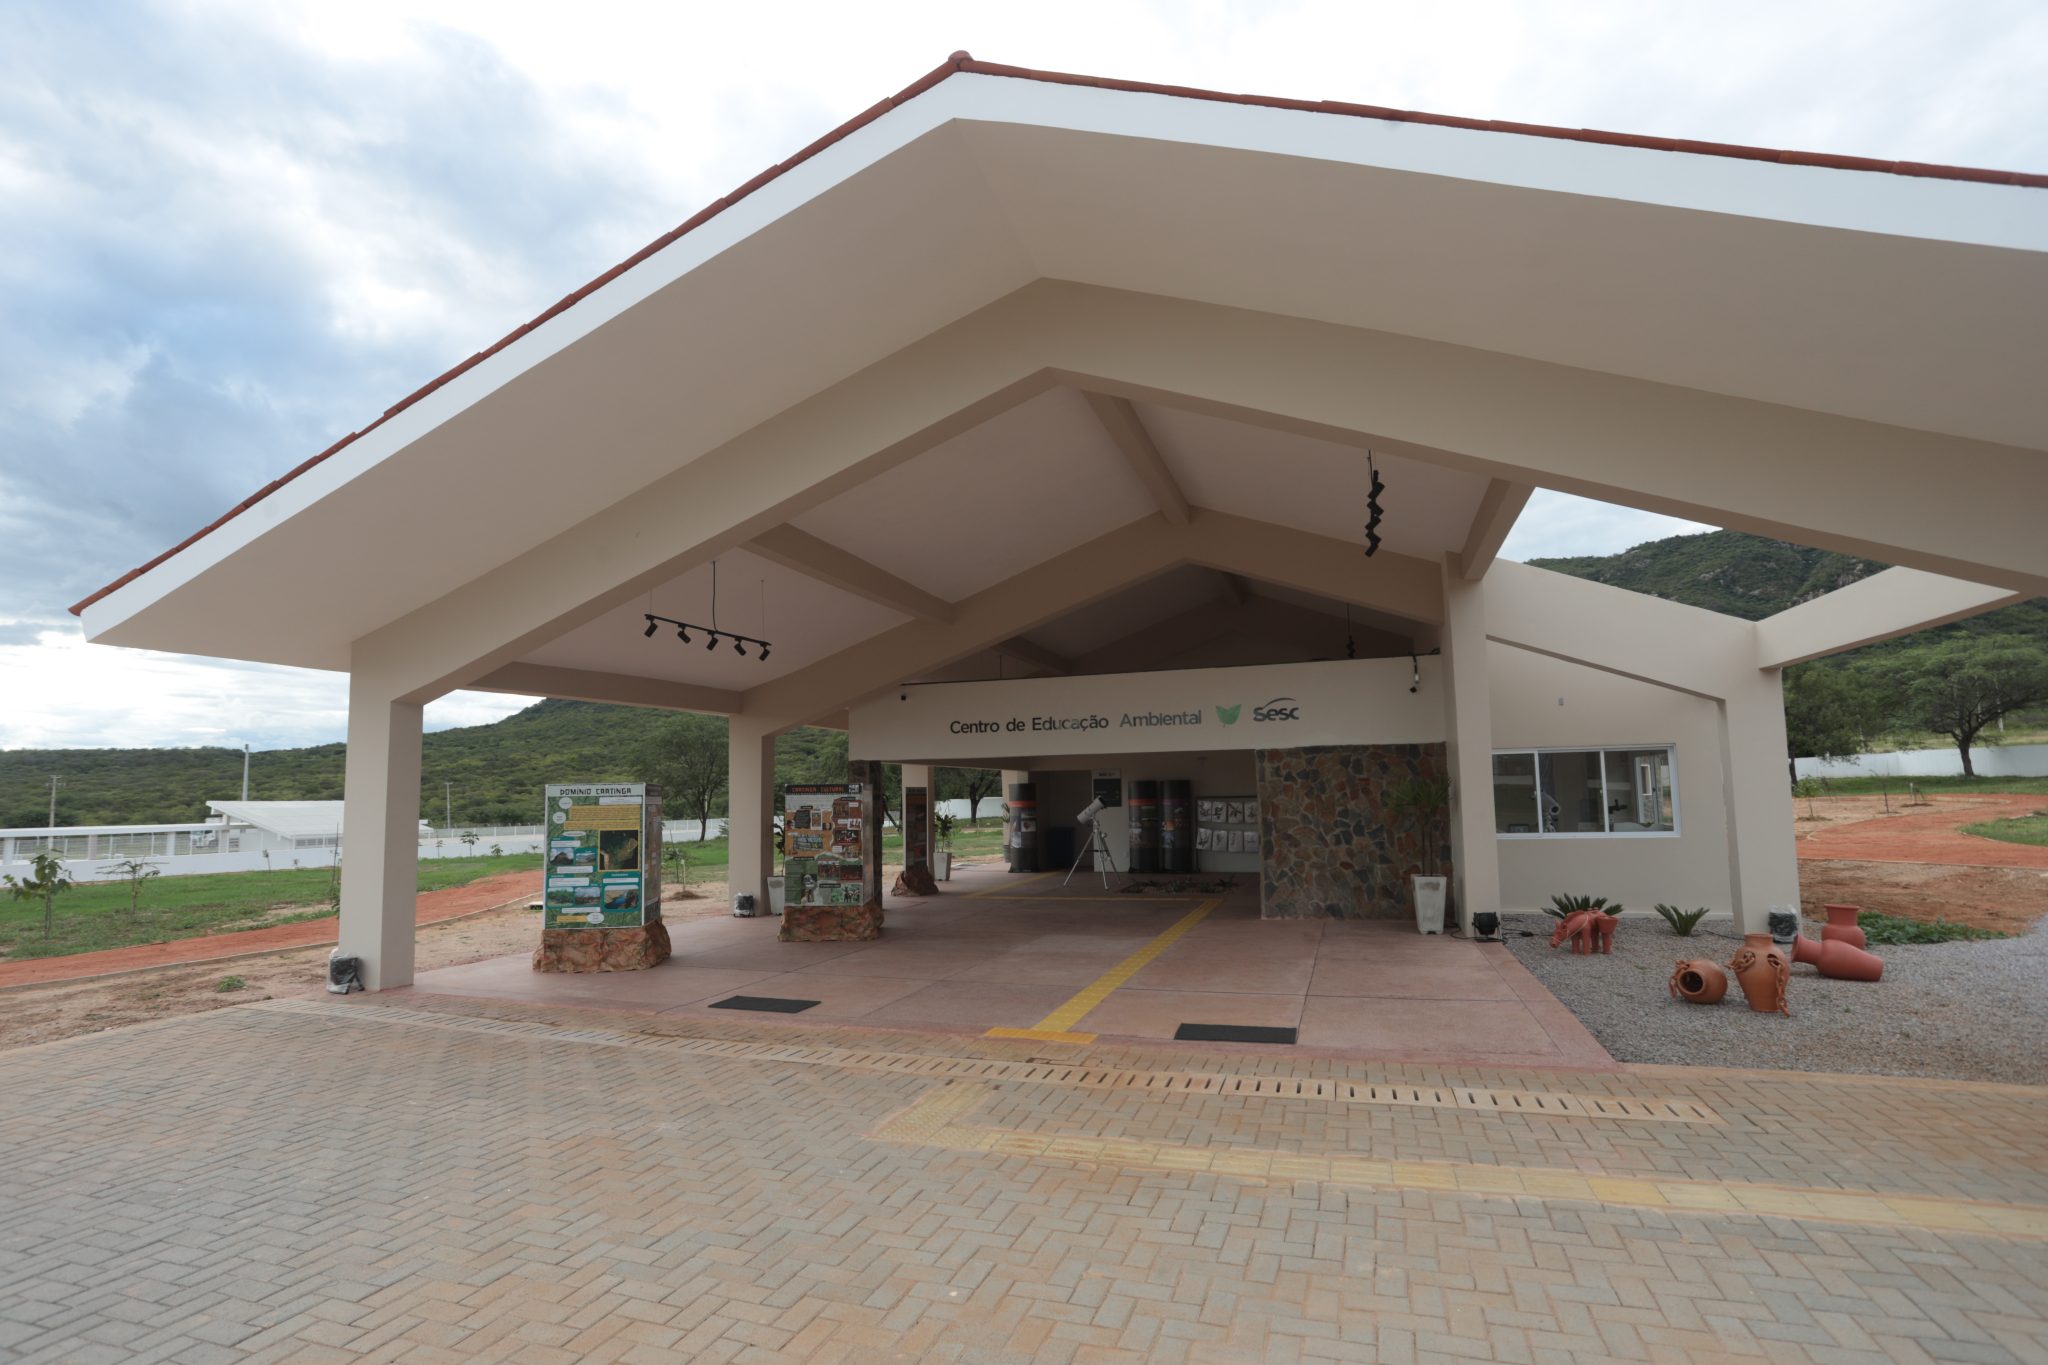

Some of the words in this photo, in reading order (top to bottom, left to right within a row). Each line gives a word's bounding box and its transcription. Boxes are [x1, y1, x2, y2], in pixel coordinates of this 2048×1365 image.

[949, 720, 1000, 734] Centro
[1006, 717, 1026, 732] de
[1032, 714, 1110, 732] Educação
[1119, 709, 1202, 728] Ambiental
